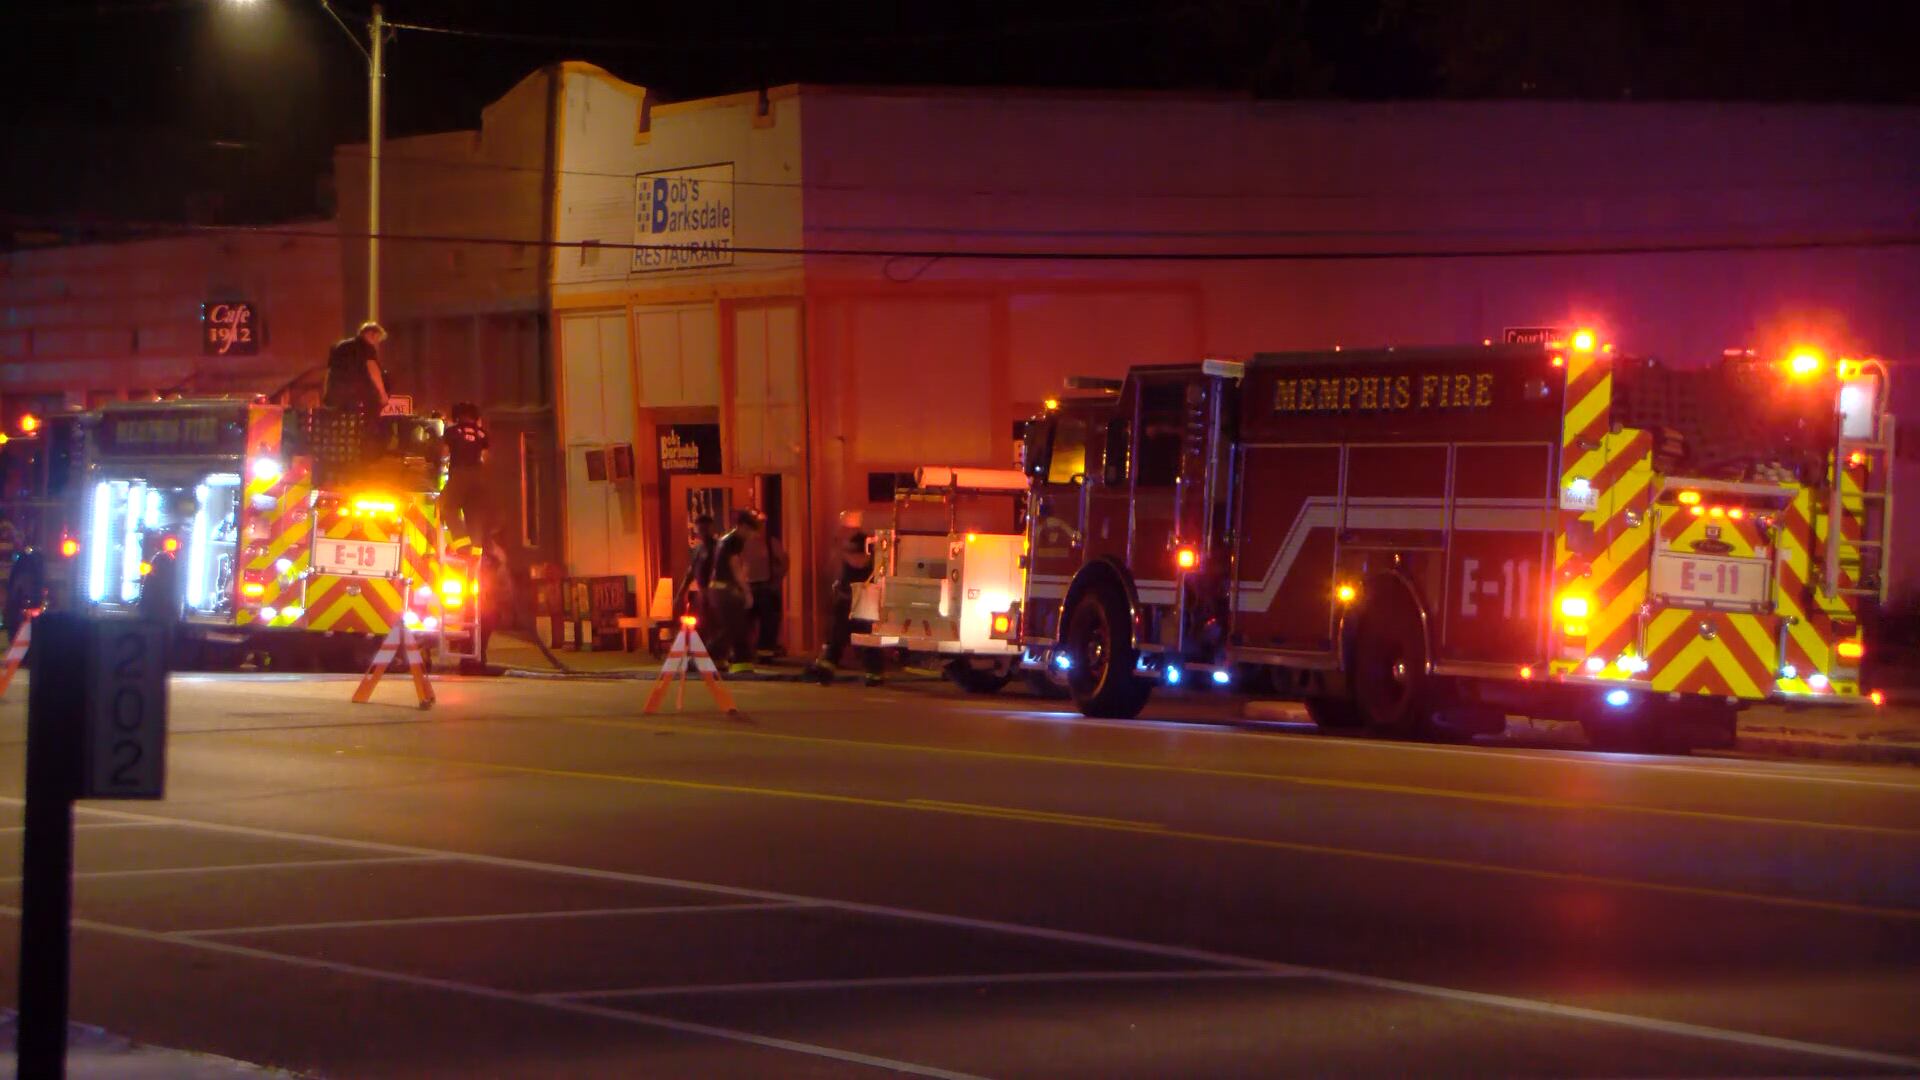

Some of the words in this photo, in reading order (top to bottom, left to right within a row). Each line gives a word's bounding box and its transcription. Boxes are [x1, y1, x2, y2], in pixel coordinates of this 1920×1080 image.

[635, 239, 730, 266] RESTAURANT
[1273, 375, 1411, 411] MEMPHIS
[1419, 373, 1494, 408] FIRE
[335, 544, 376, 567] E-13
[1461, 559, 1530, 619] E-11
[1680, 561, 1739, 595] E-11
[111, 631, 148, 788] 202
